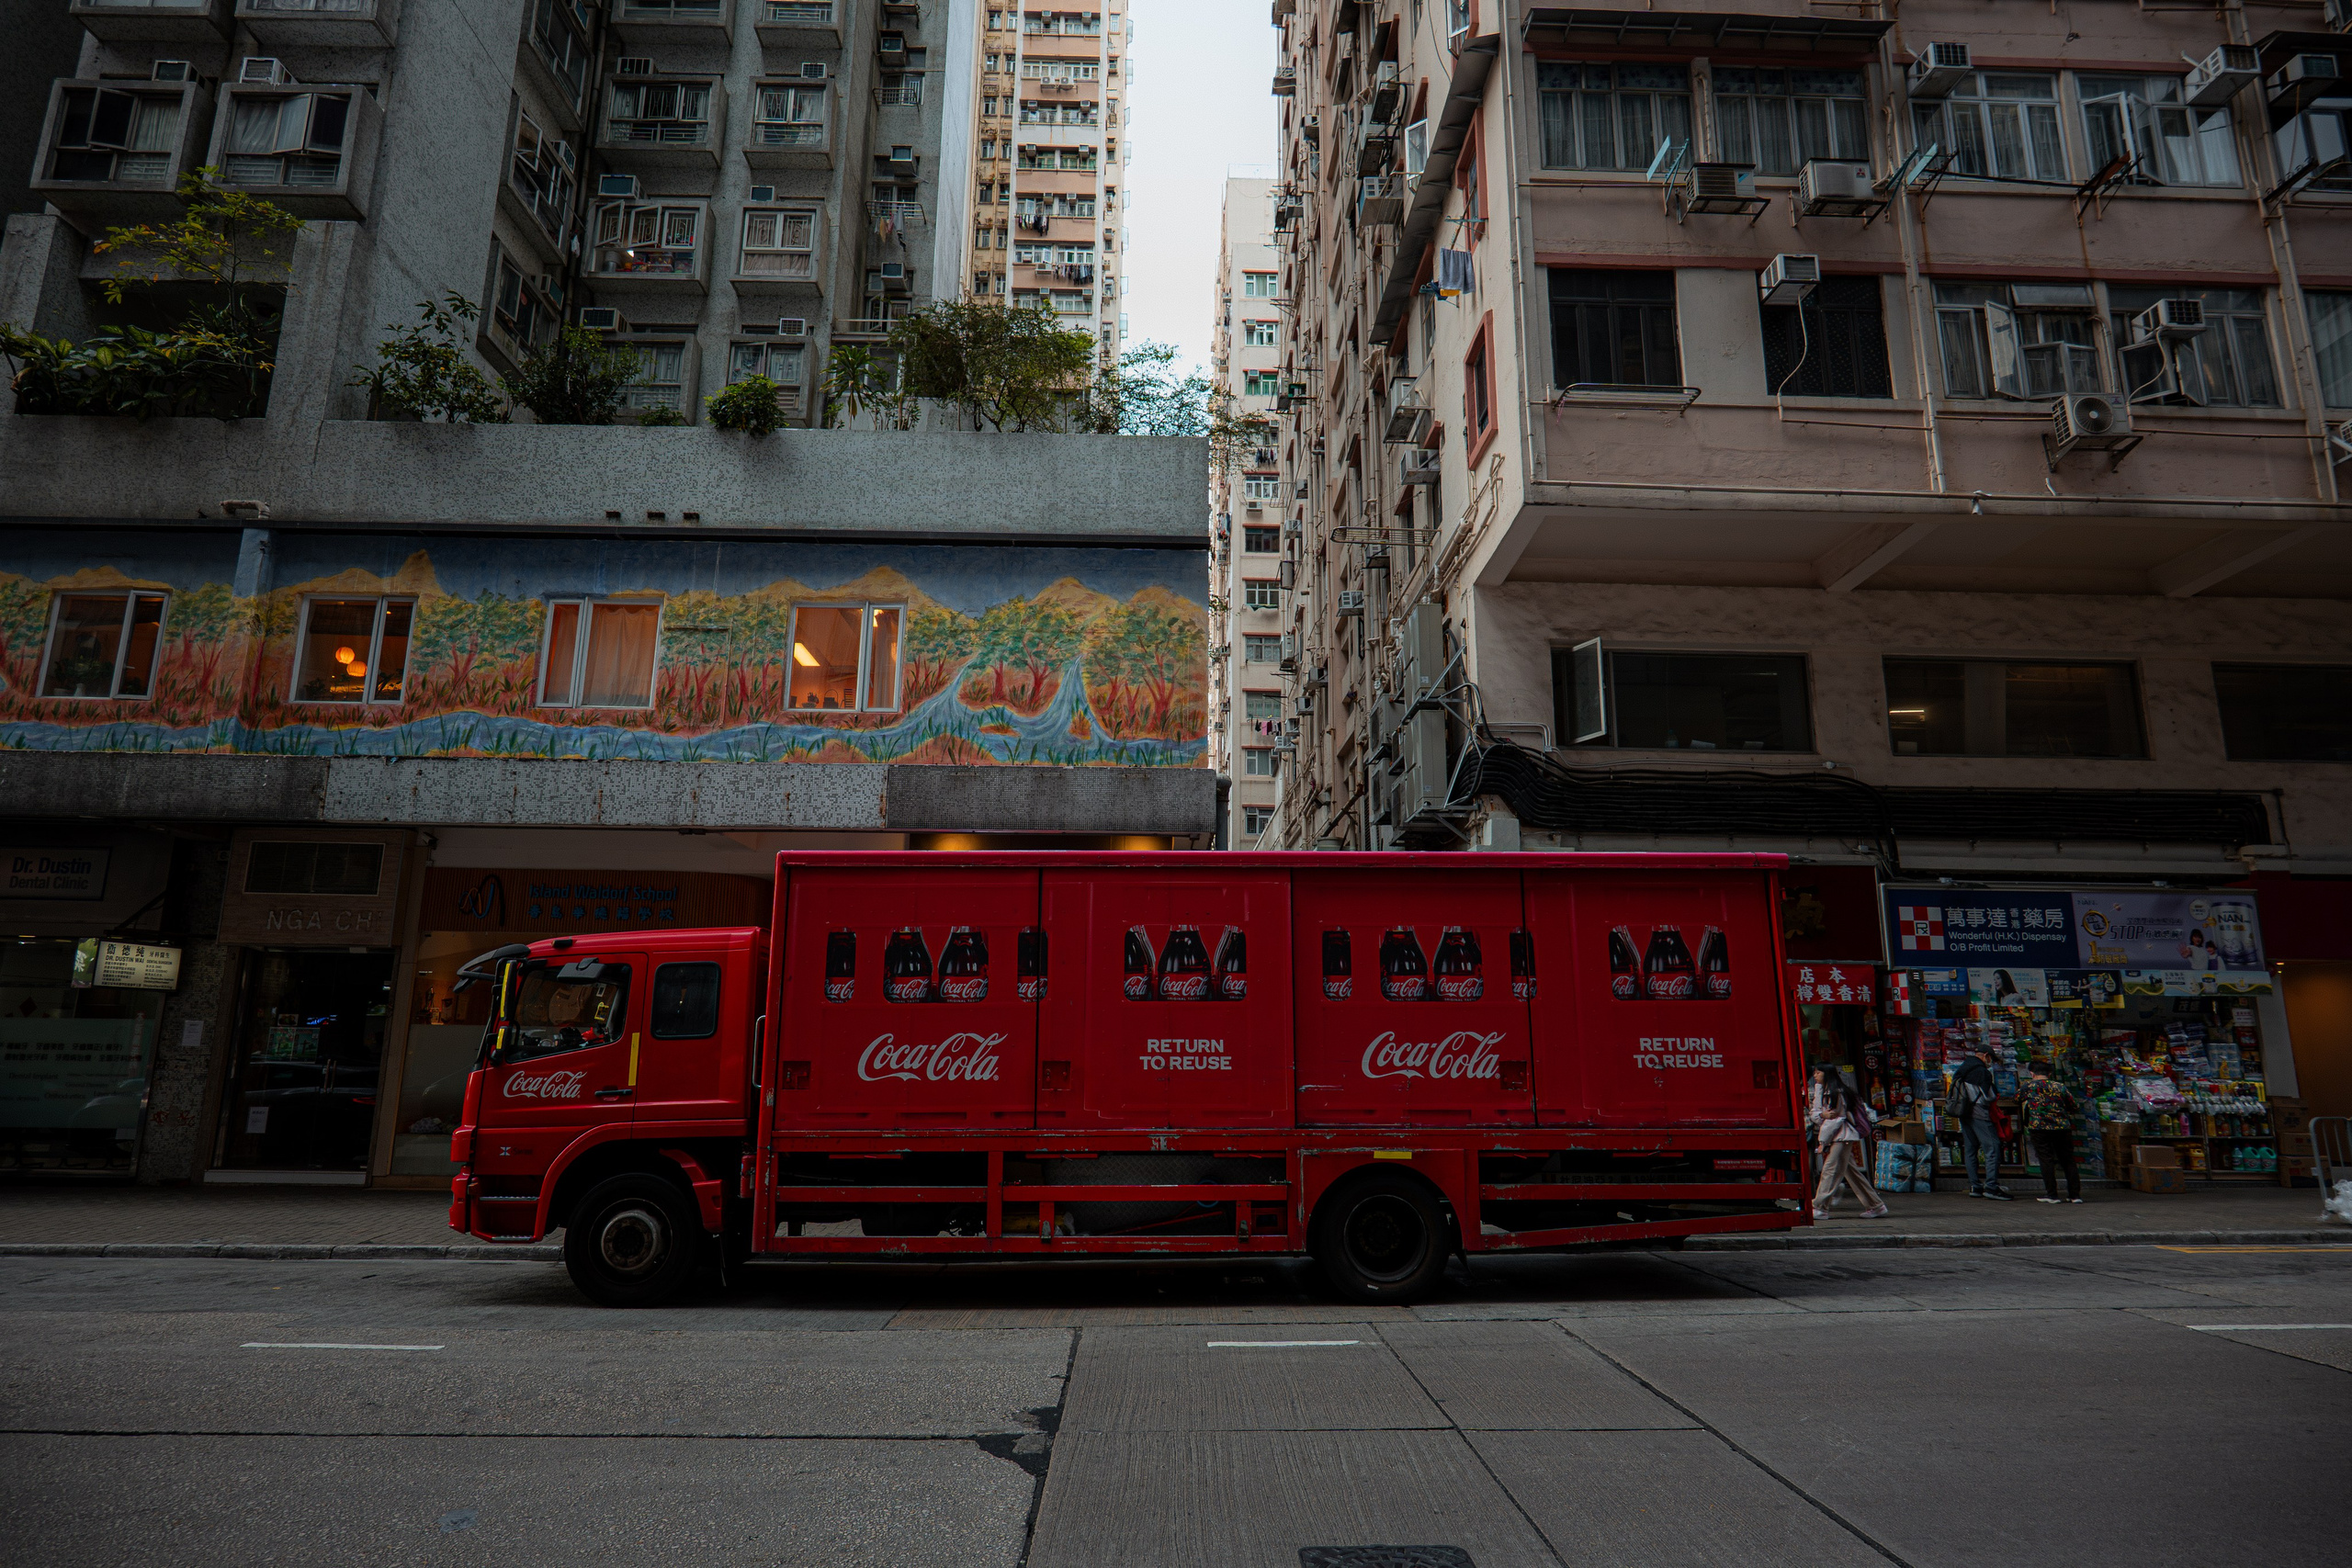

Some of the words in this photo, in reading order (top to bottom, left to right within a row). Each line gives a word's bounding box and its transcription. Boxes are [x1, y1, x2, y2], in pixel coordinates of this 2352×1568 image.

[13, 856, 33, 874] Dr.
[39, 857, 92, 874] Dustin
[9, 875, 50, 889] Dental
[53, 876, 89, 890] Clinic
[529, 883, 570, 898] Island
[574, 884, 631, 902] Waldorf
[632, 886, 678, 903] School
[266, 909, 322, 931] NGA
[2218, 913, 2244, 923] NAN
[1949, 931, 1993, 941] Wonderful
[1995, 931, 2020, 942] (H.K.)
[2022, 931, 2066, 943] Dispensay
[1950, 942, 1966, 952] O/B
[1969, 942, 1990, 953] Profit
[1992, 943, 2024, 953] Limited
[940, 978, 988, 998] Coca-Cola
[1160, 976, 1209, 996] Coca-Cola
[1437, 977, 1483, 998] Coca-Cola
[1647, 976, 1693, 995] Coca-Cola
[1147, 1039, 1224, 1053] RETURN
[1639, 1037, 1715, 1052] RETURN
[857, 1032, 1009, 1081] Coca-Cola
[1139, 1055, 1166, 1070] TO
[1170, 1055, 1232, 1070] REUSE
[1362, 1031, 1507, 1079] Coca-Cola
[1633, 1054, 1659, 1068] TO
[1662, 1054, 1724, 1068] REUSE
[503, 1070, 587, 1099] Coca-Cola
